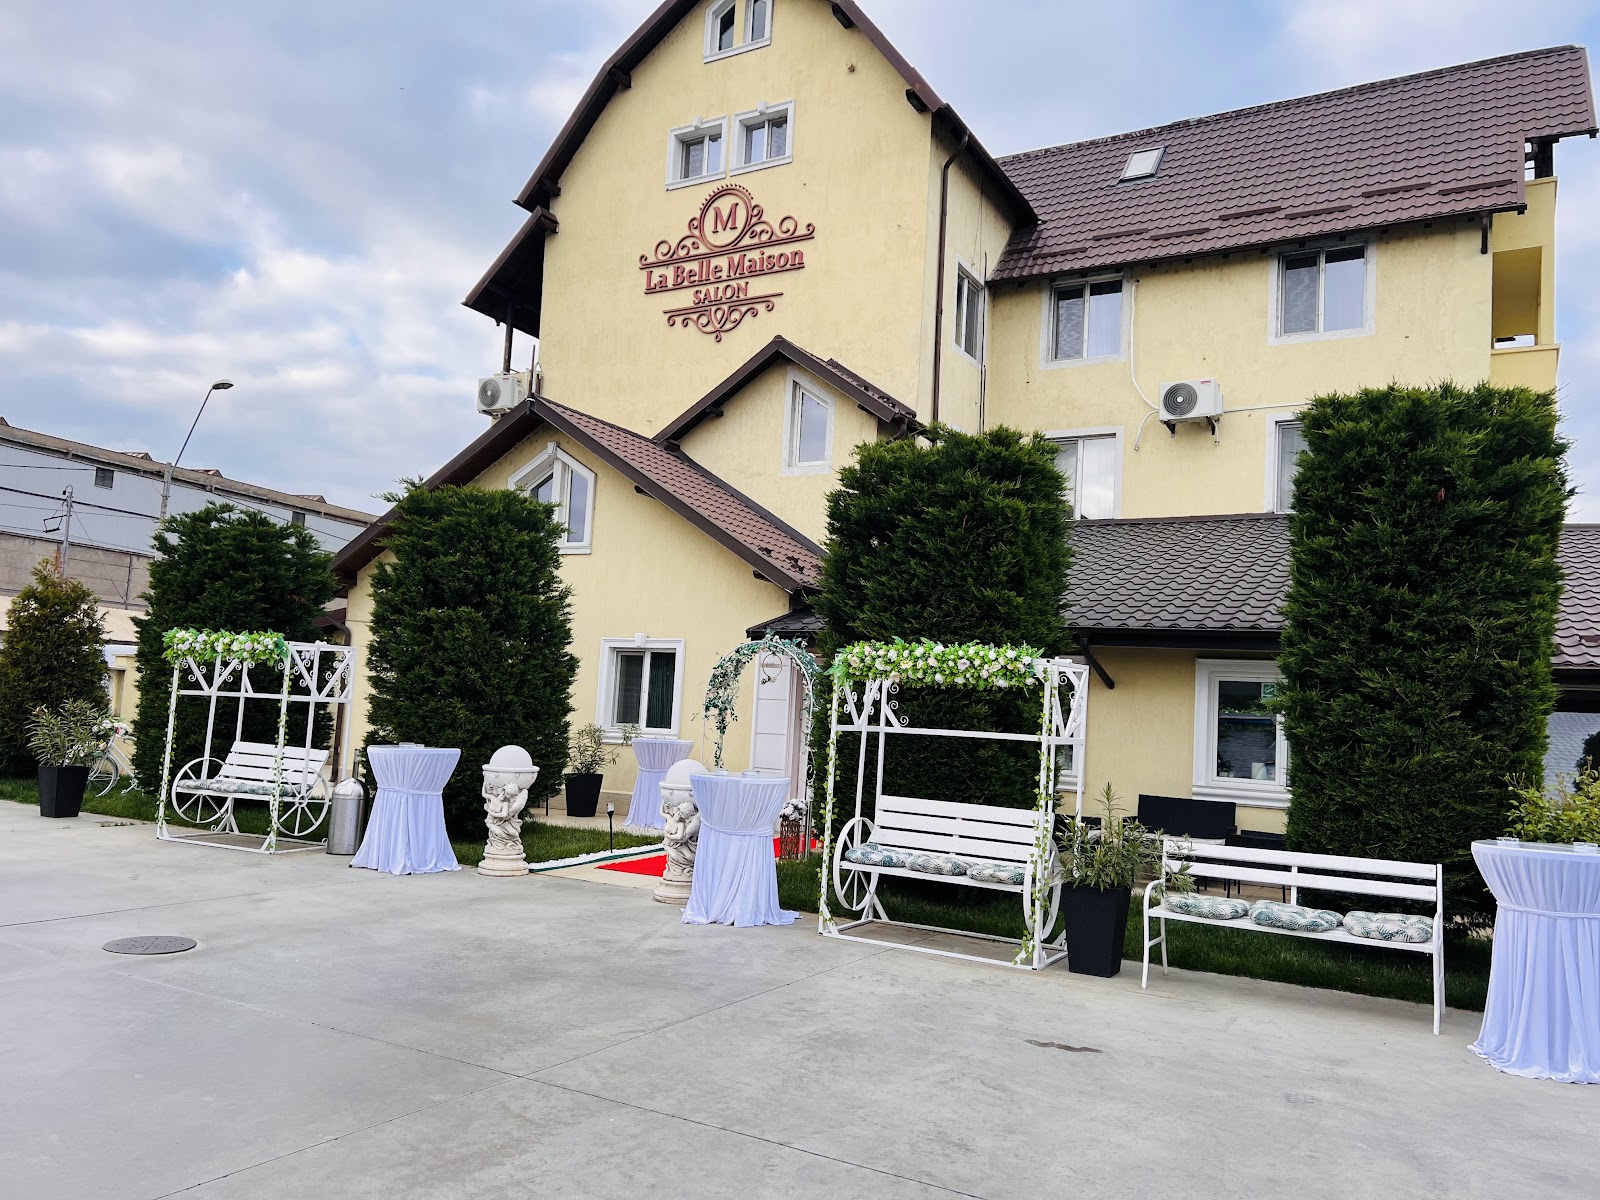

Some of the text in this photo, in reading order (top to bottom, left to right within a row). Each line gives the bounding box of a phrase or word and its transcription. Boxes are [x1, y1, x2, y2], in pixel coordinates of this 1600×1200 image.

[711, 202, 739, 233] M
[645, 250, 804, 290] La Belle Maison
[692, 282, 749, 305] SALON
